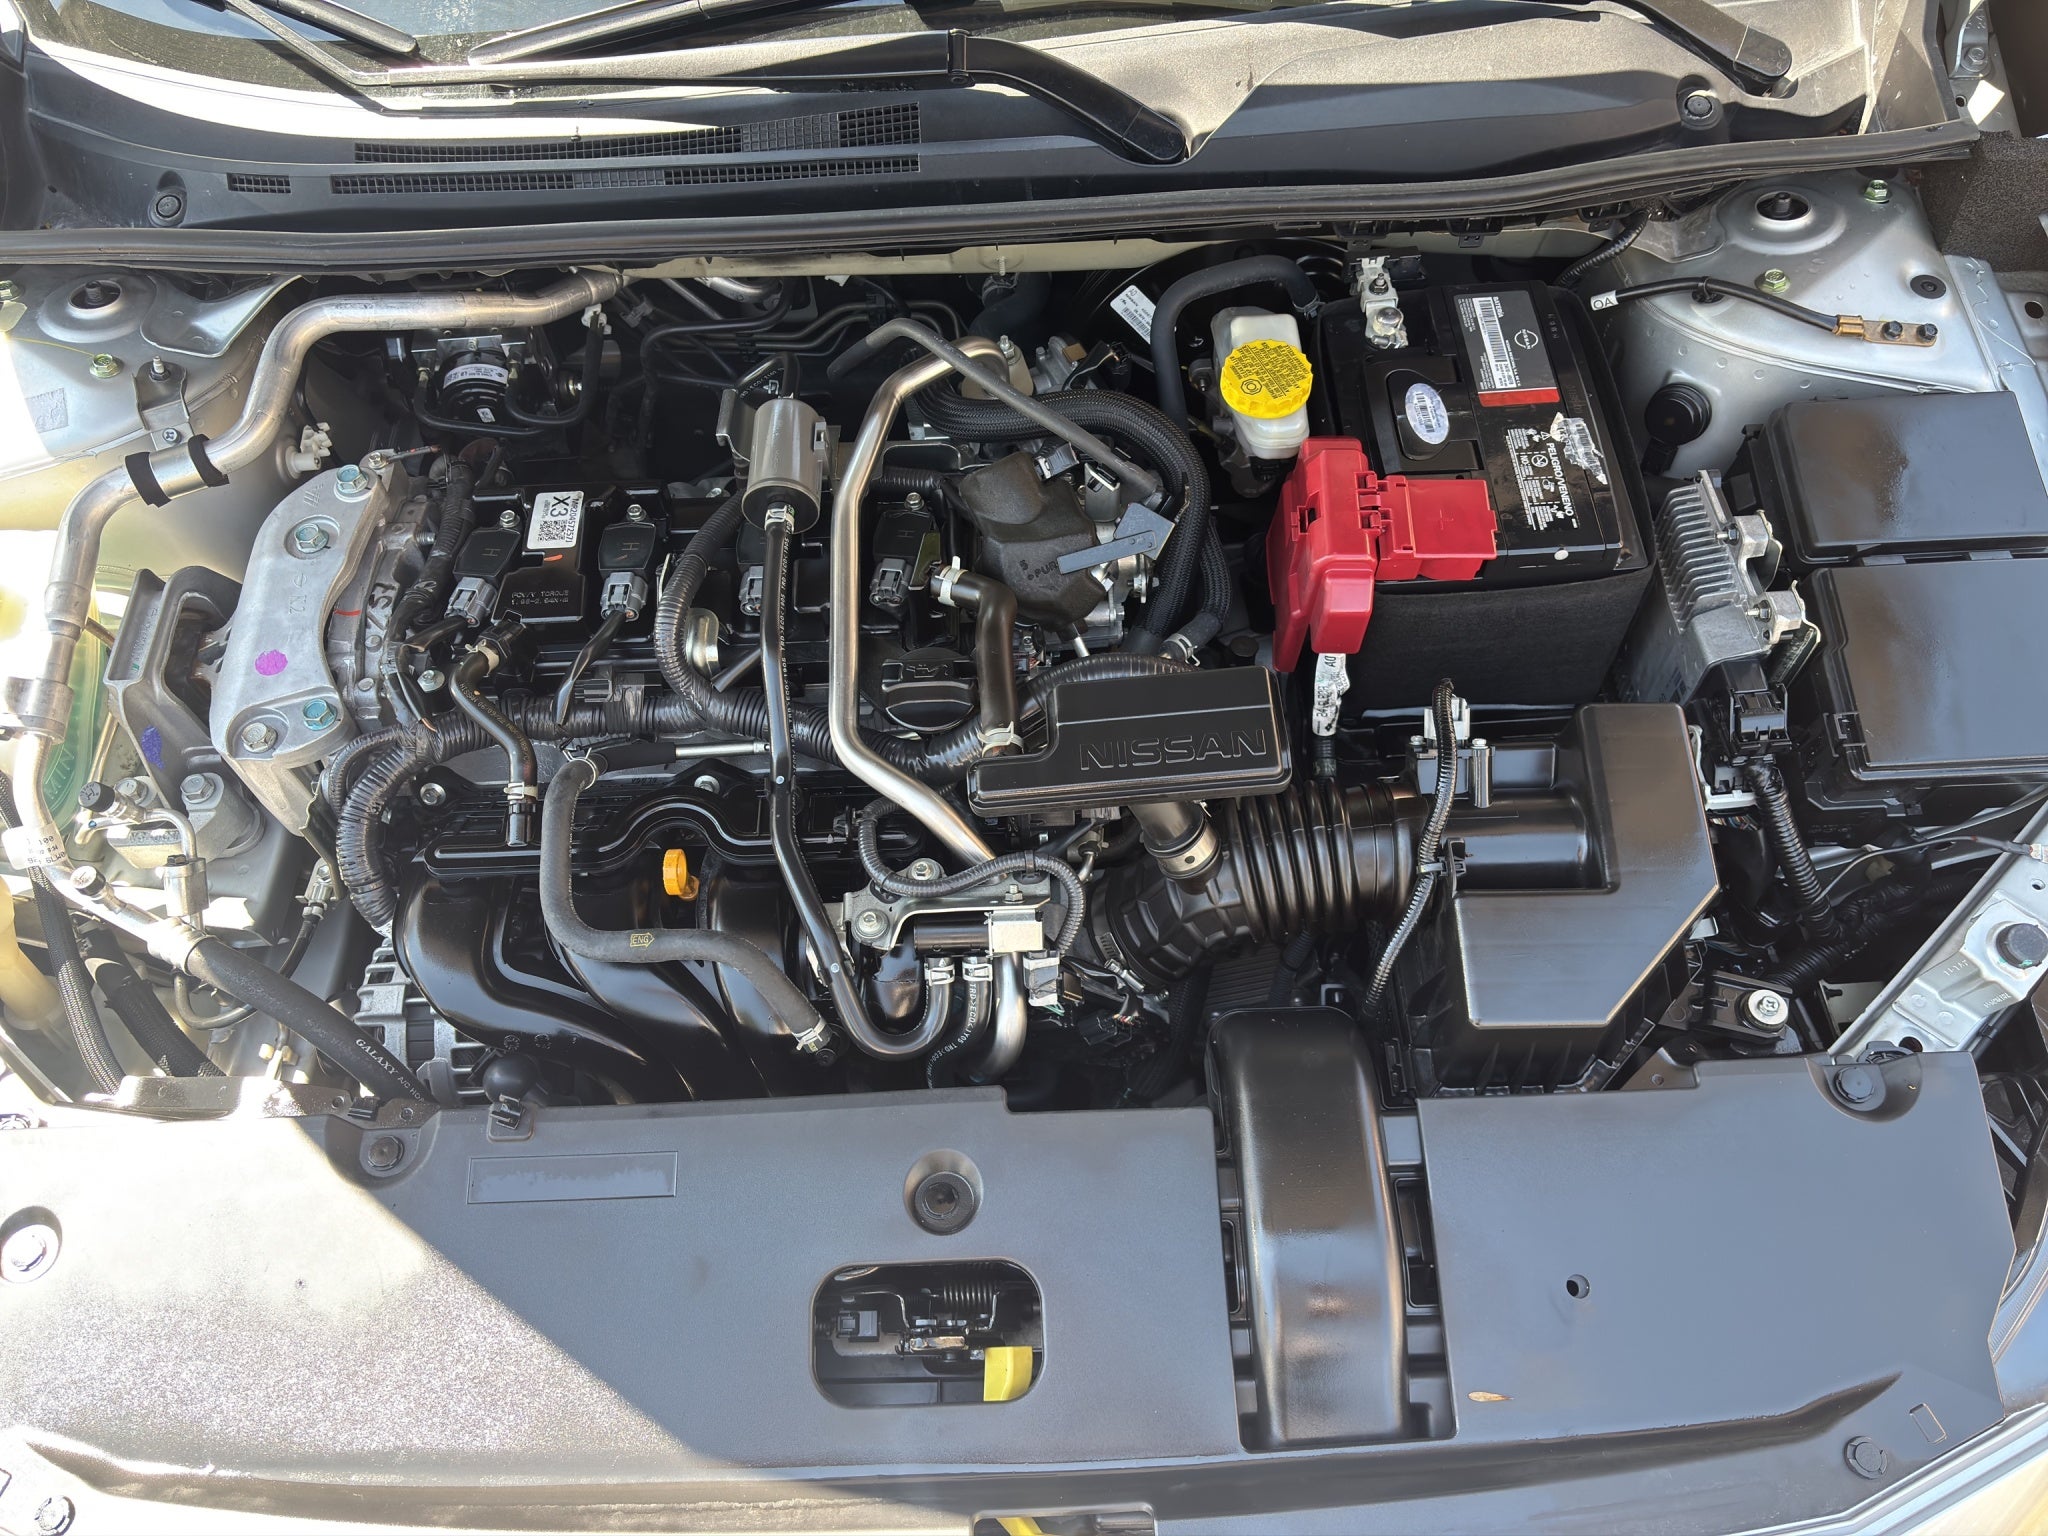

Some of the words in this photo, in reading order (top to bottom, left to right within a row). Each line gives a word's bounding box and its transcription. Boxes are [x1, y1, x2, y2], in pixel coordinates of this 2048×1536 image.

[1521, 329, 1532, 350] NISSAN
[1546, 442, 1574, 516] PELIGRO/VENENO
[550, 496, 570, 518] X3
[1079, 728, 1266, 770] NISSAN
[632, 935, 649, 944] ENG
[355, 1037, 398, 1076] GALAXY
